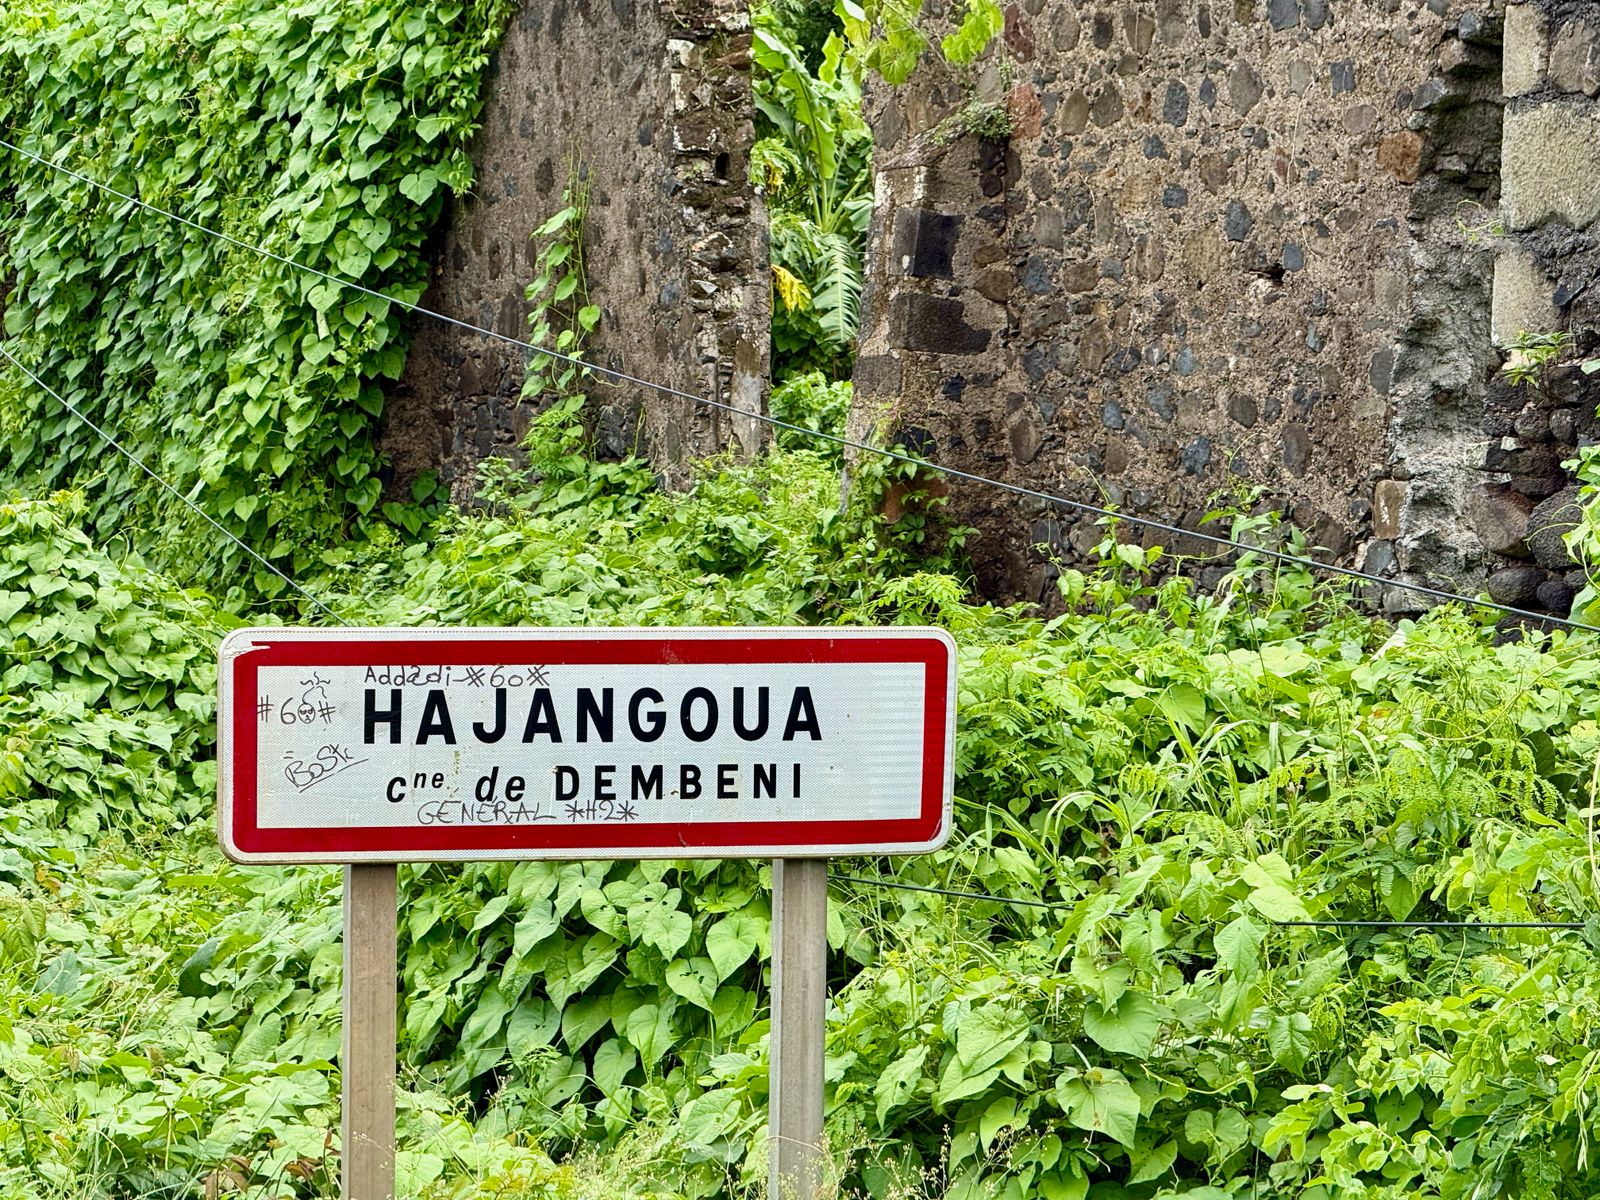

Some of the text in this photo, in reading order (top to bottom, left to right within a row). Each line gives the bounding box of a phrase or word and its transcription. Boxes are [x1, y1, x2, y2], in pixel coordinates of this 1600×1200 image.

[364, 686, 822, 744] HAJANGOUA
[475, 766, 526, 803] de
[555, 763, 801, 802] DEMBENI
